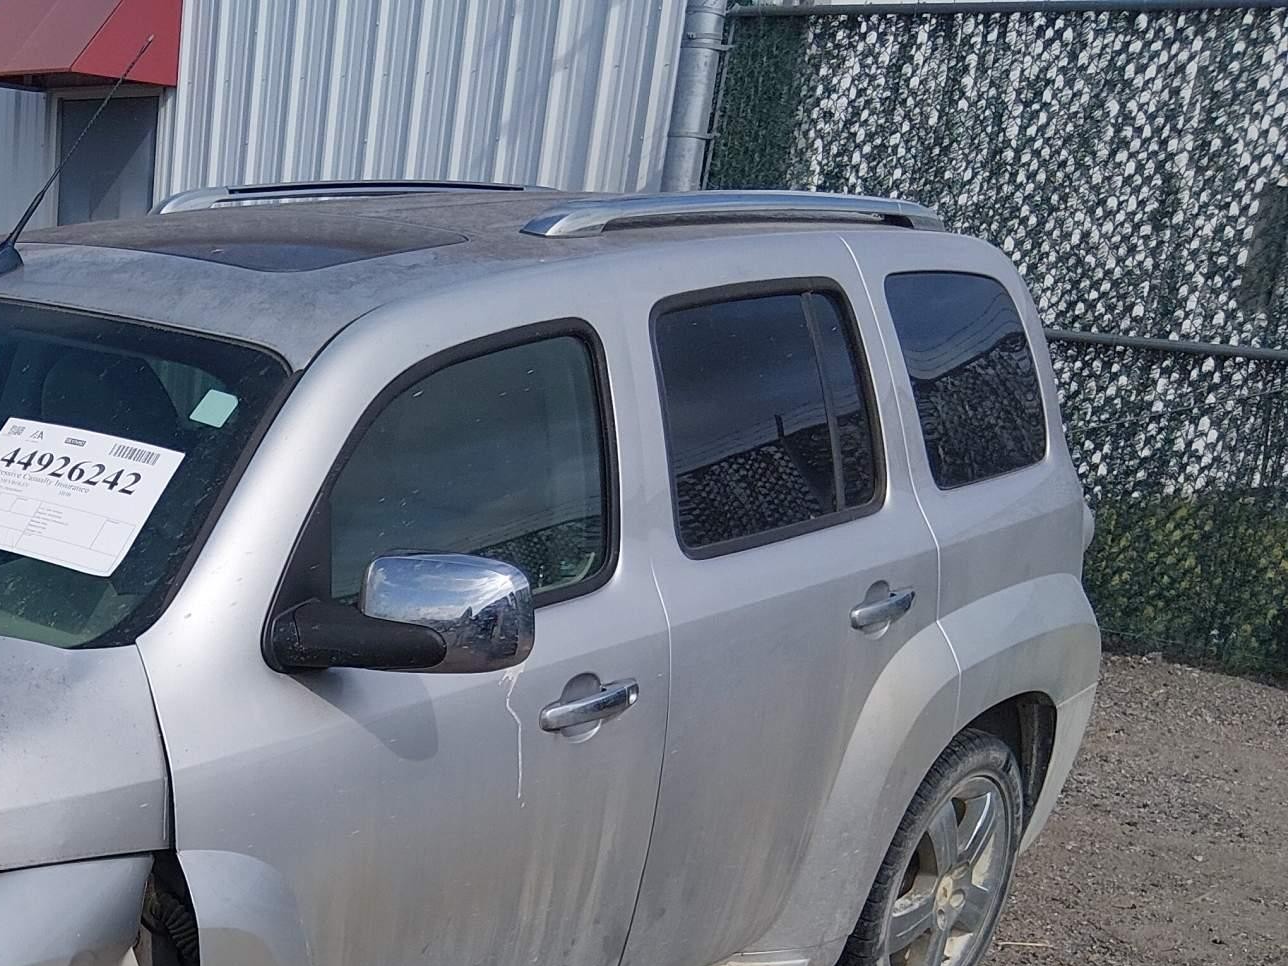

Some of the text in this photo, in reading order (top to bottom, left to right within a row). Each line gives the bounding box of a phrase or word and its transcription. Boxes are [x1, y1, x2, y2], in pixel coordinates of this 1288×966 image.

[0, 447, 142, 496] 44926242
[22, 472, 53, 486] Casualty
[54, 479, 91, 494] Insurance
